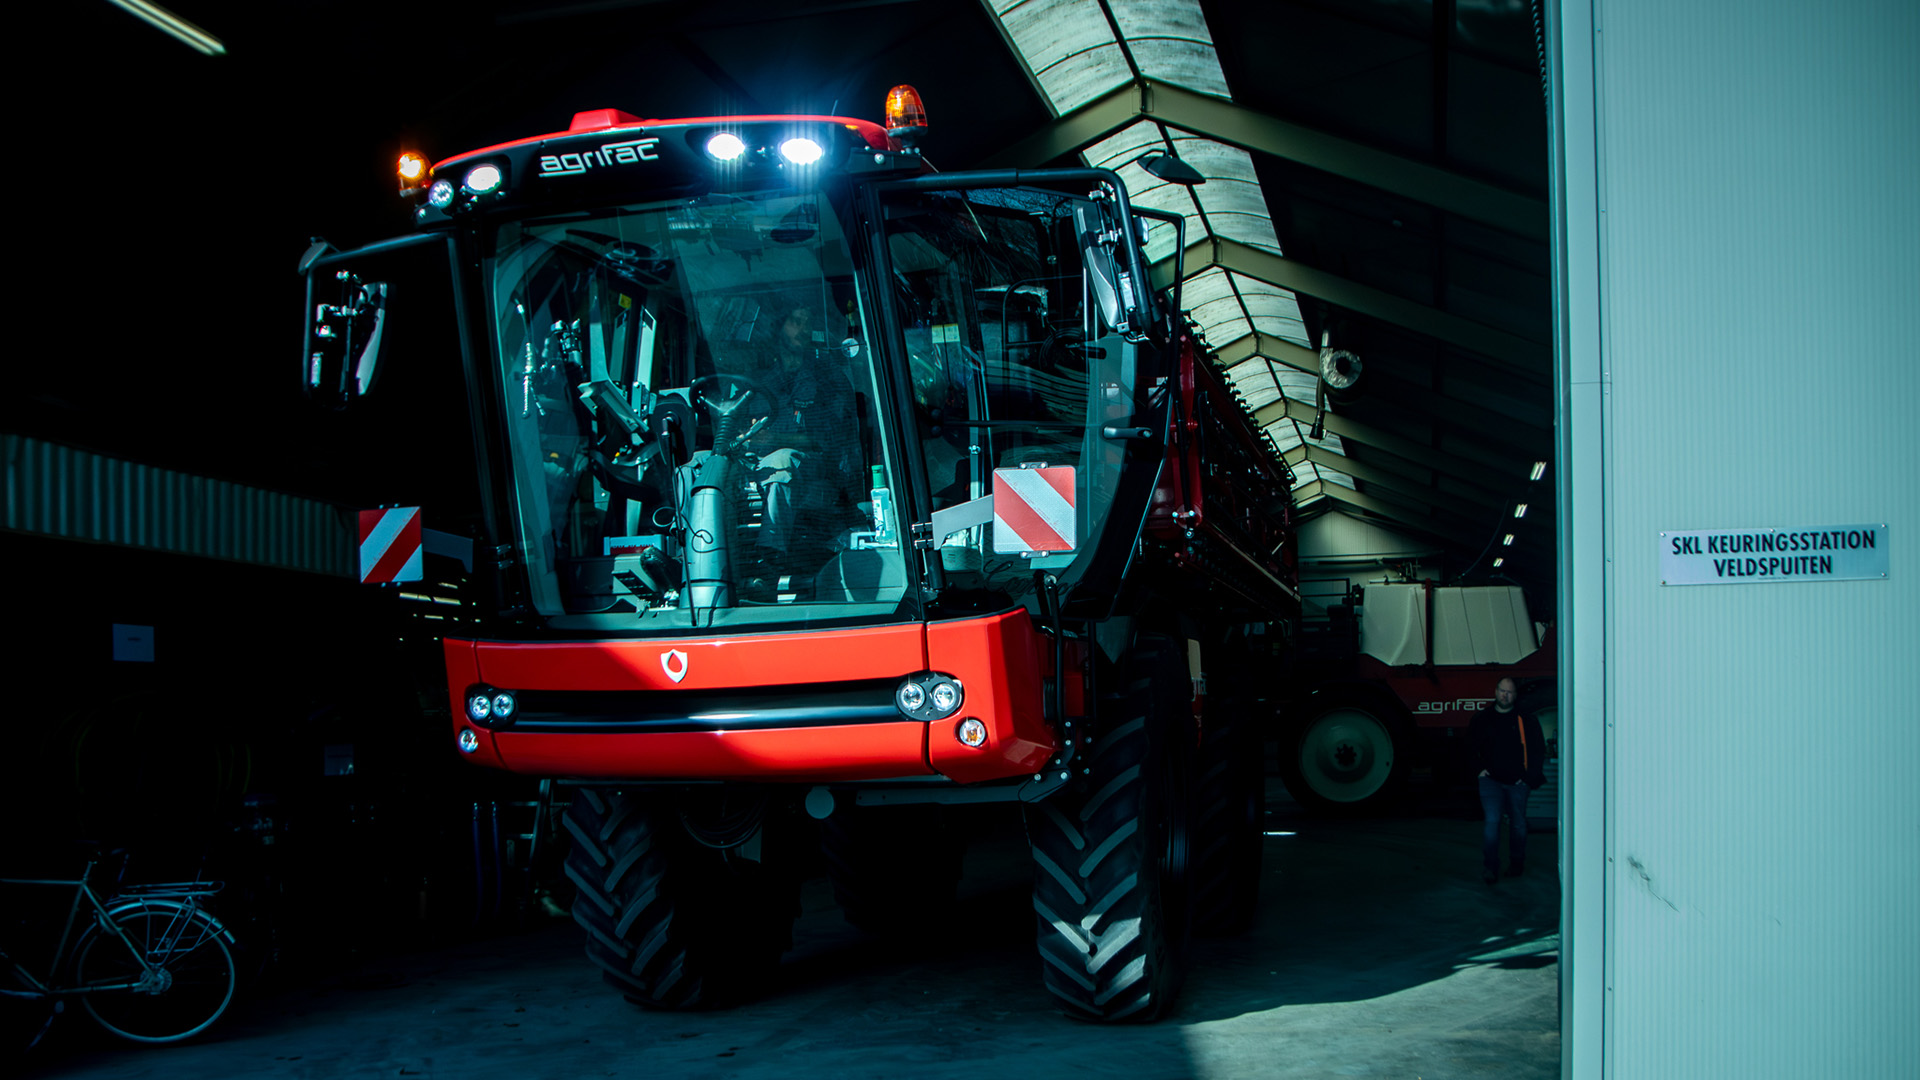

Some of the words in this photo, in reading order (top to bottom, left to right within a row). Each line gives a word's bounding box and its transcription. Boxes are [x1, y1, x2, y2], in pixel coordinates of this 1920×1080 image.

[538, 137, 660, 178] agrifac
[1672, 535, 1703, 555] SKL
[1708, 529, 1876, 554] KEURINGSSTATION
[1713, 555, 1833, 577] VELDSPUITEN
[1411, 698, 1497, 714] agrifac
